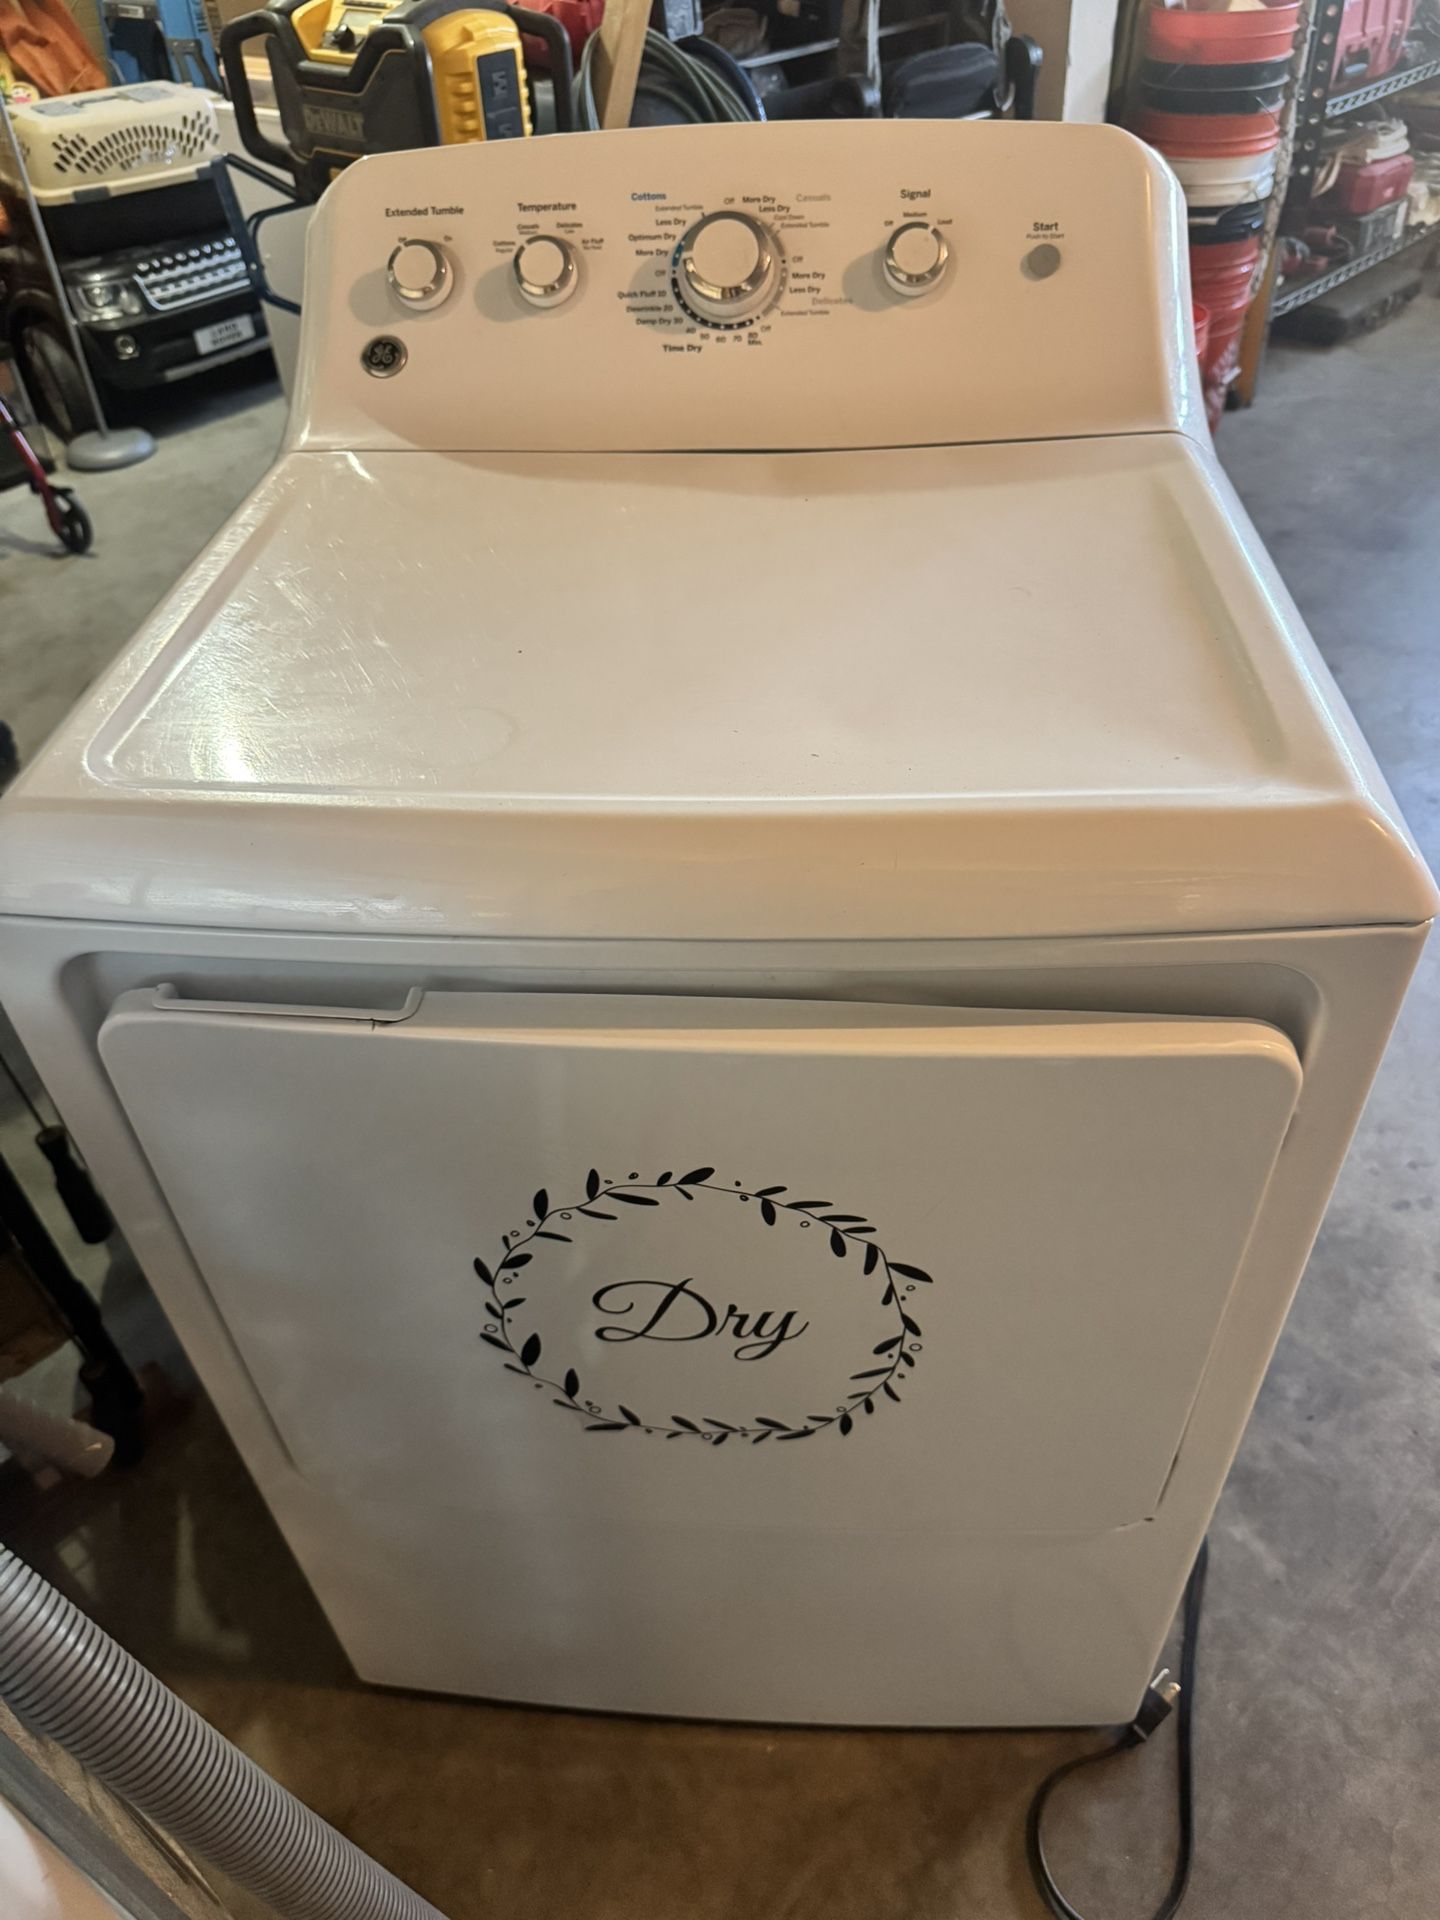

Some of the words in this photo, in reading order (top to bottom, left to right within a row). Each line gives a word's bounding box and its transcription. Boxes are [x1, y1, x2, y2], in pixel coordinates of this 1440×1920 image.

[631, 192, 667, 201] Cottons
[742, 196, 761, 204] More
[763, 195, 776, 204] Dry
[796, 193, 831, 202] Casuals
[900, 189, 932, 201] Signal
[385, 207, 429, 217] Extended
[430, 206, 464, 215] Tumble
[517, 202, 577, 212] Temperature
[758, 205, 776, 213] Less
[777, 204, 791, 213] Dry
[674, 218, 687, 226] Dry
[1033, 221, 1059, 232] Start
[628, 234, 663, 242] Optimum
[664, 233, 677, 241] Dry
[635, 248, 654, 256] More
[655, 248, 669, 257] Dry
[792, 272, 811, 280] More
[812, 271, 825, 280] Dry
[789, 286, 806, 294] Less
[807, 285, 821, 294] Dry
[636, 318, 657, 326] Damp
[658, 317, 672, 326] Dry
[663, 344, 685, 353] Time
[687, 344, 703, 354] Dry
[592, 1278, 809, 1361] Dry
